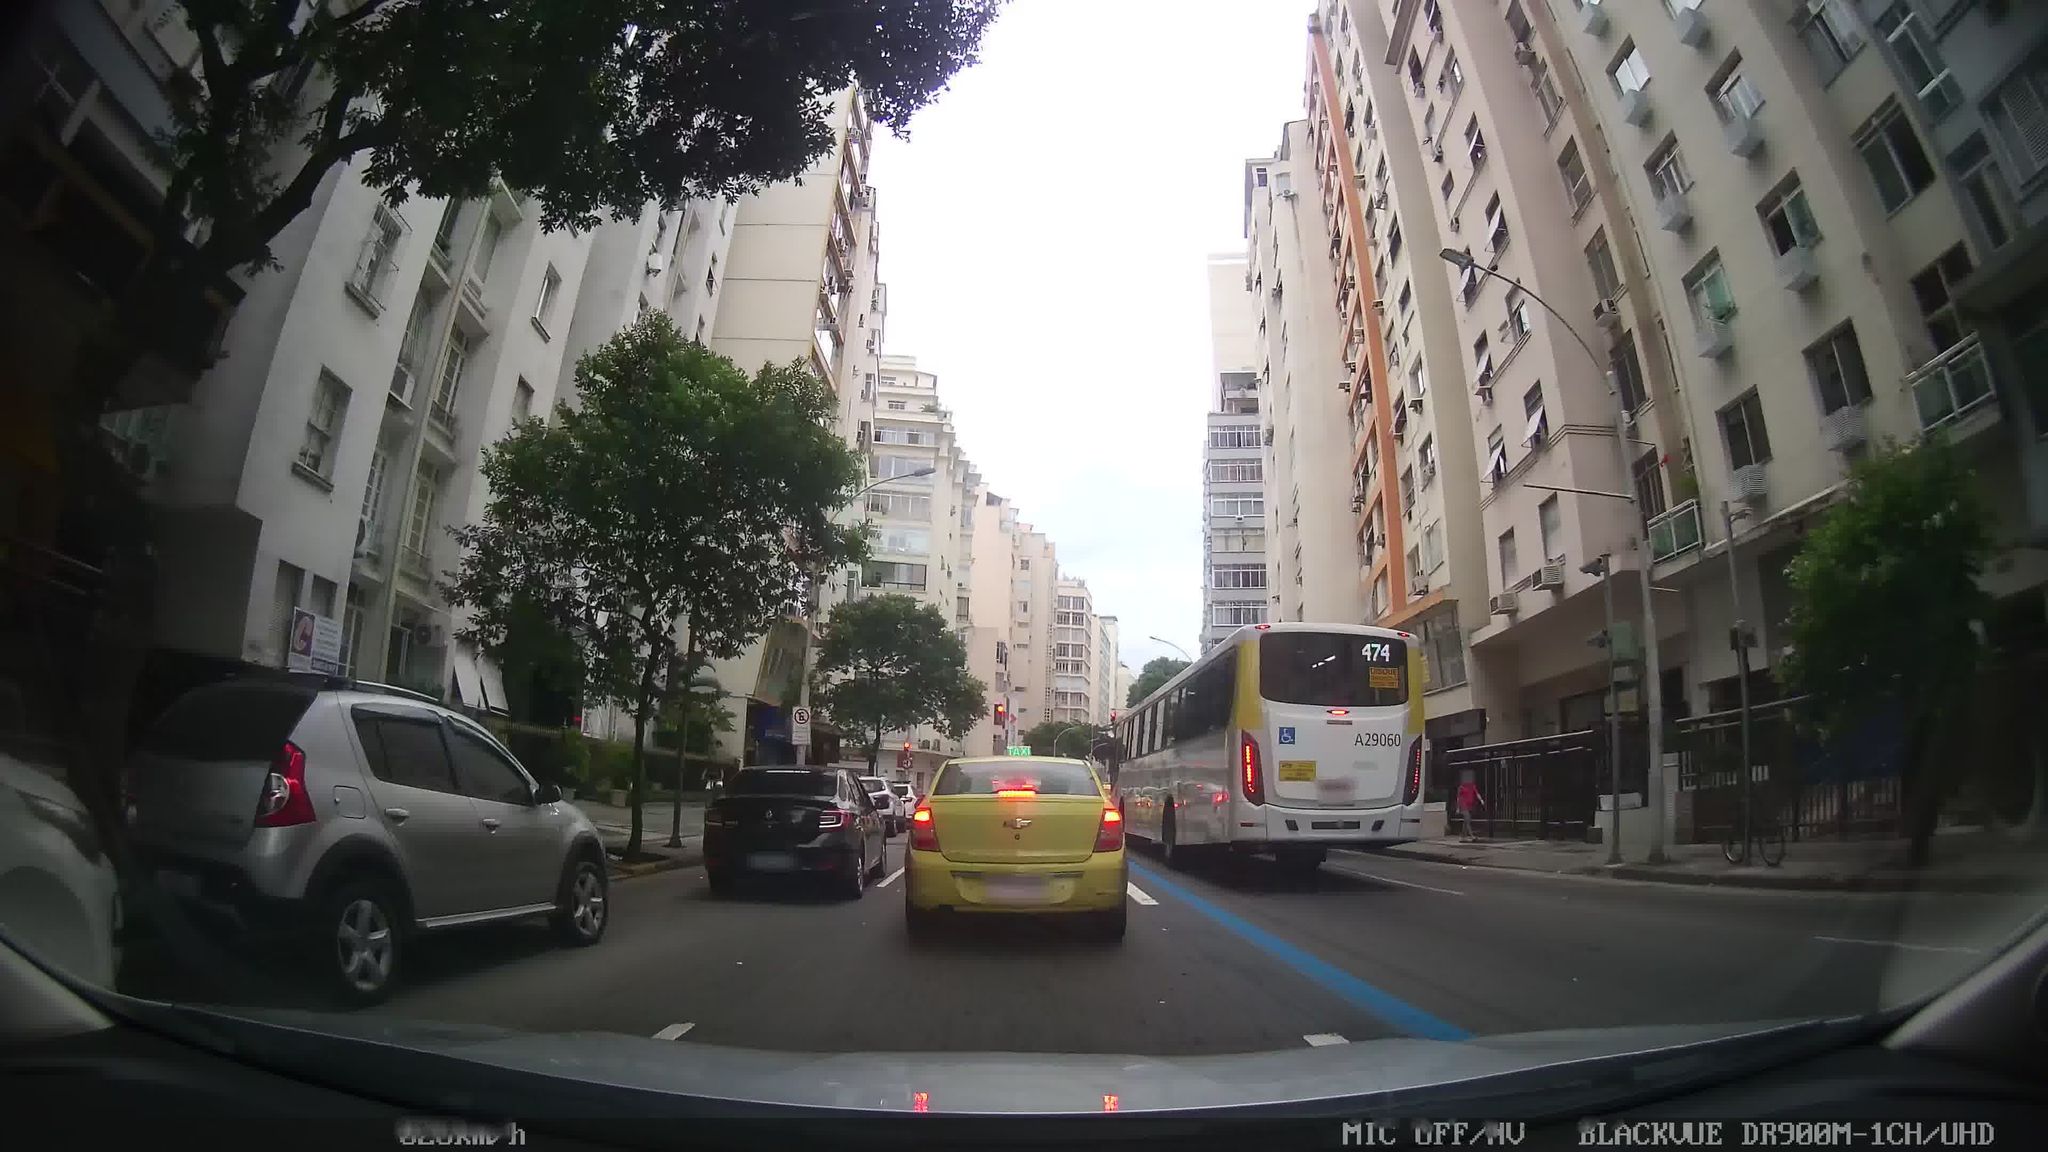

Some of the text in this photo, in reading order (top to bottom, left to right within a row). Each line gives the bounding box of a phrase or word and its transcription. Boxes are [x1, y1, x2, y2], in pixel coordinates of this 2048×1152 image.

[1361, 643, 1390, 662] 474
[1354, 733, 1401, 747] A29060
[1008, 747, 1031, 756] TAXI
